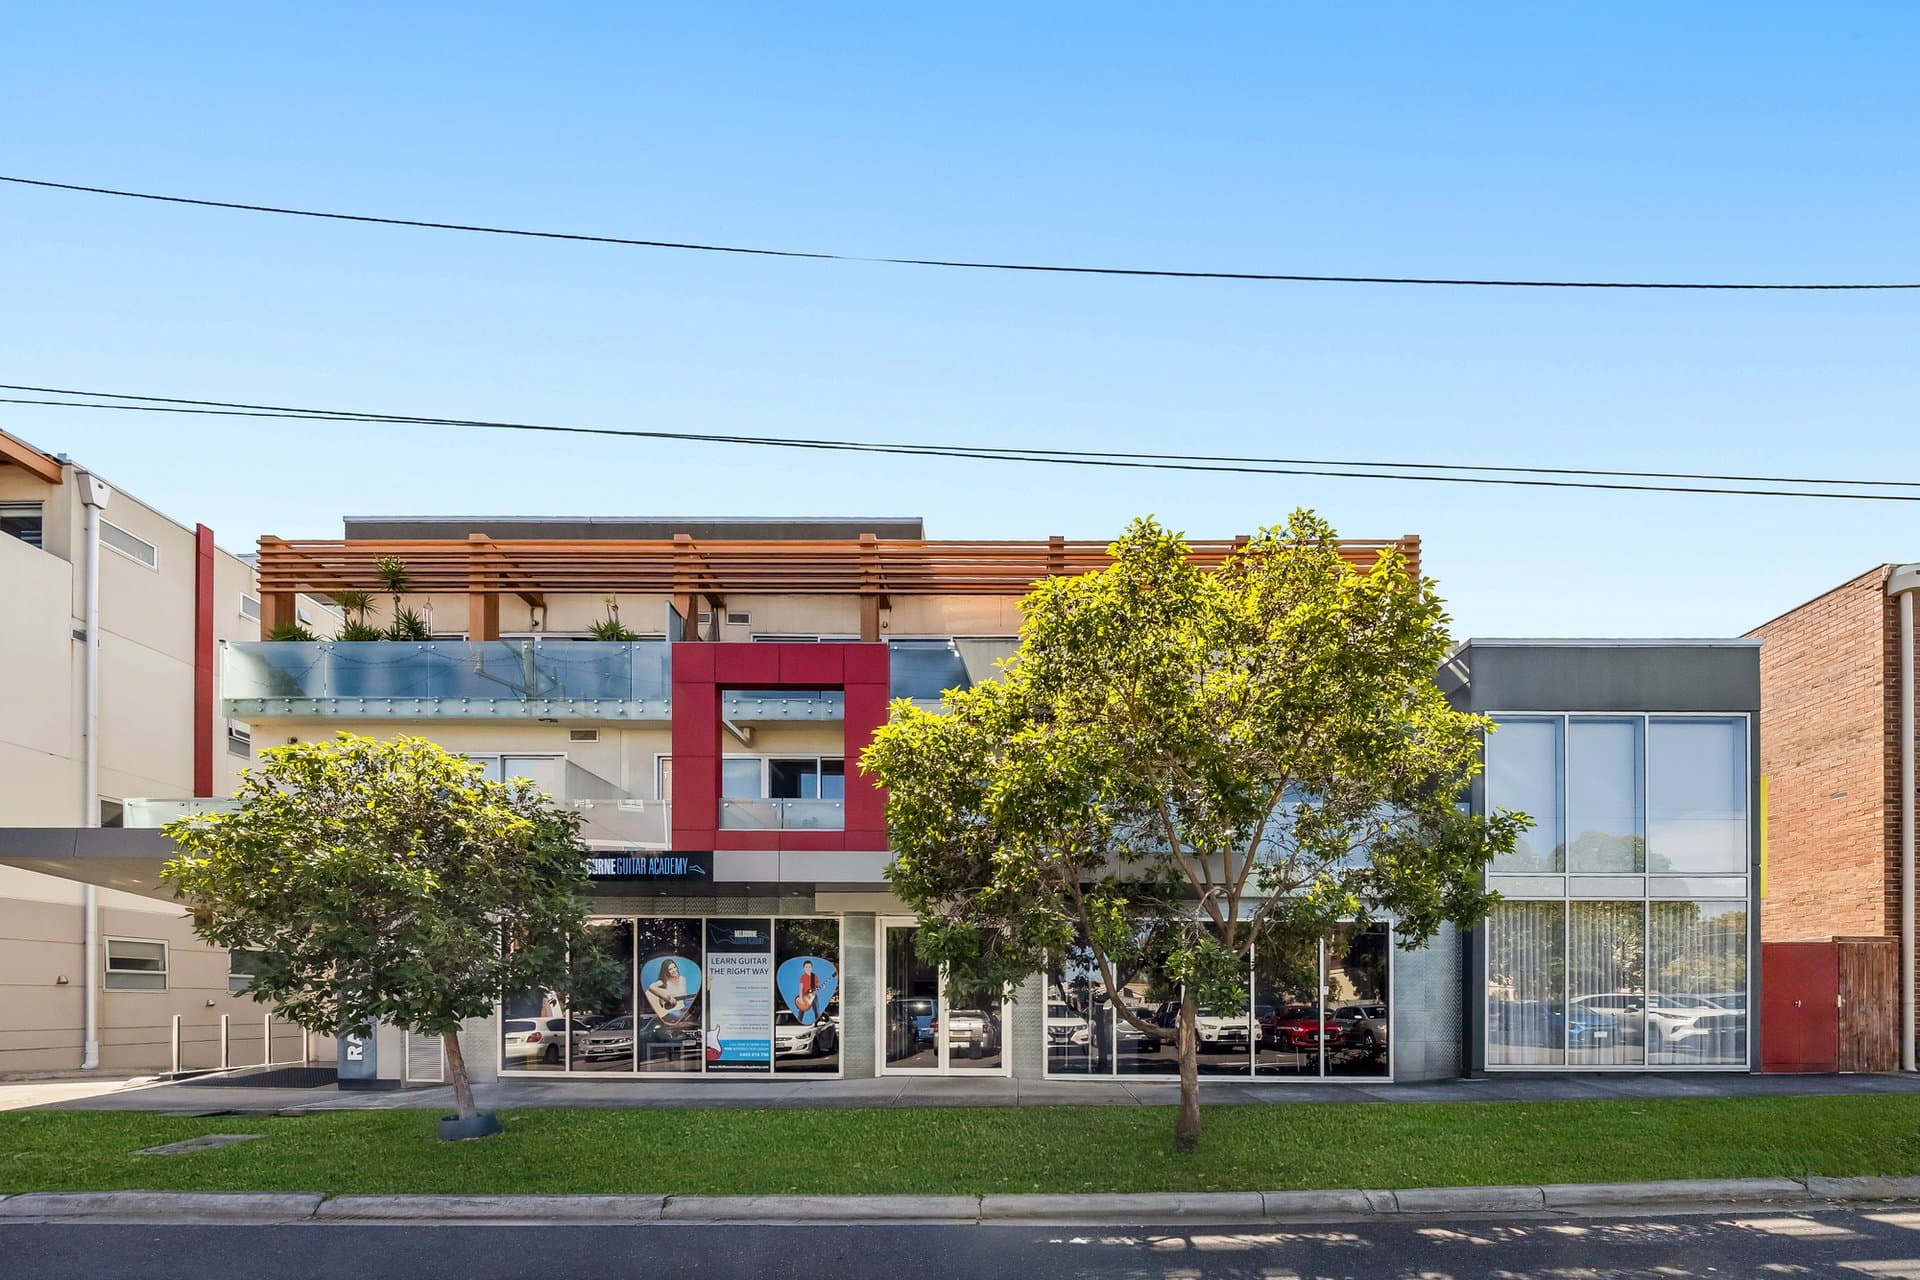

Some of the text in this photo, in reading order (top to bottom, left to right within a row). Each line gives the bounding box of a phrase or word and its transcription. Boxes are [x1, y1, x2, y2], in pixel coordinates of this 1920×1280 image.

[648, 857, 688, 875] ACADEMY
[711, 957, 767, 965] LEARN GUITAR
[710, 967, 769, 975] THE RIGHT WAY
